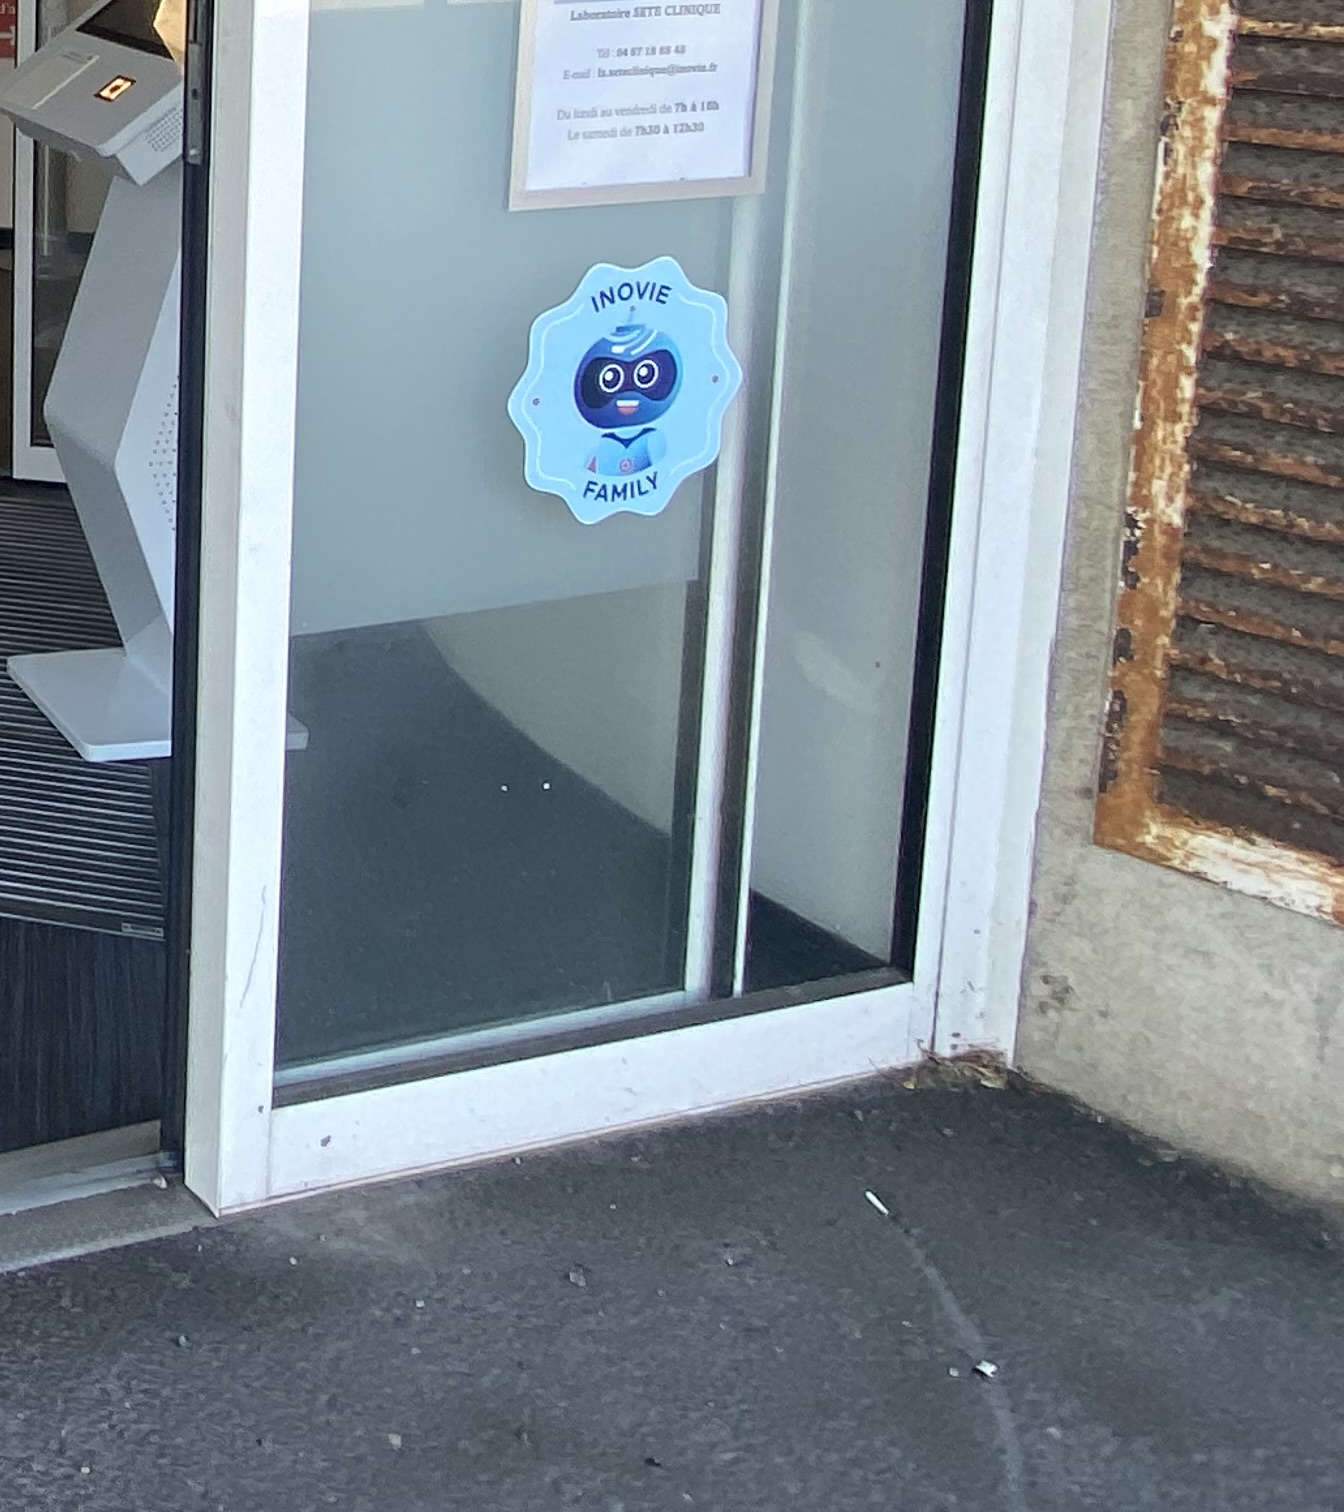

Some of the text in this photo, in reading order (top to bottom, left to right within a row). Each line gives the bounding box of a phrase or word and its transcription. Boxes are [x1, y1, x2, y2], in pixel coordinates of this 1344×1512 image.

[569, 8, 631, 21] Laboratoire
[664, 3, 721, 16] CLINIQUE
[614, 104, 657, 117] vendredi
[591, 281, 673, 313] INOVIE
[583, 471, 659, 503] FAMILY
